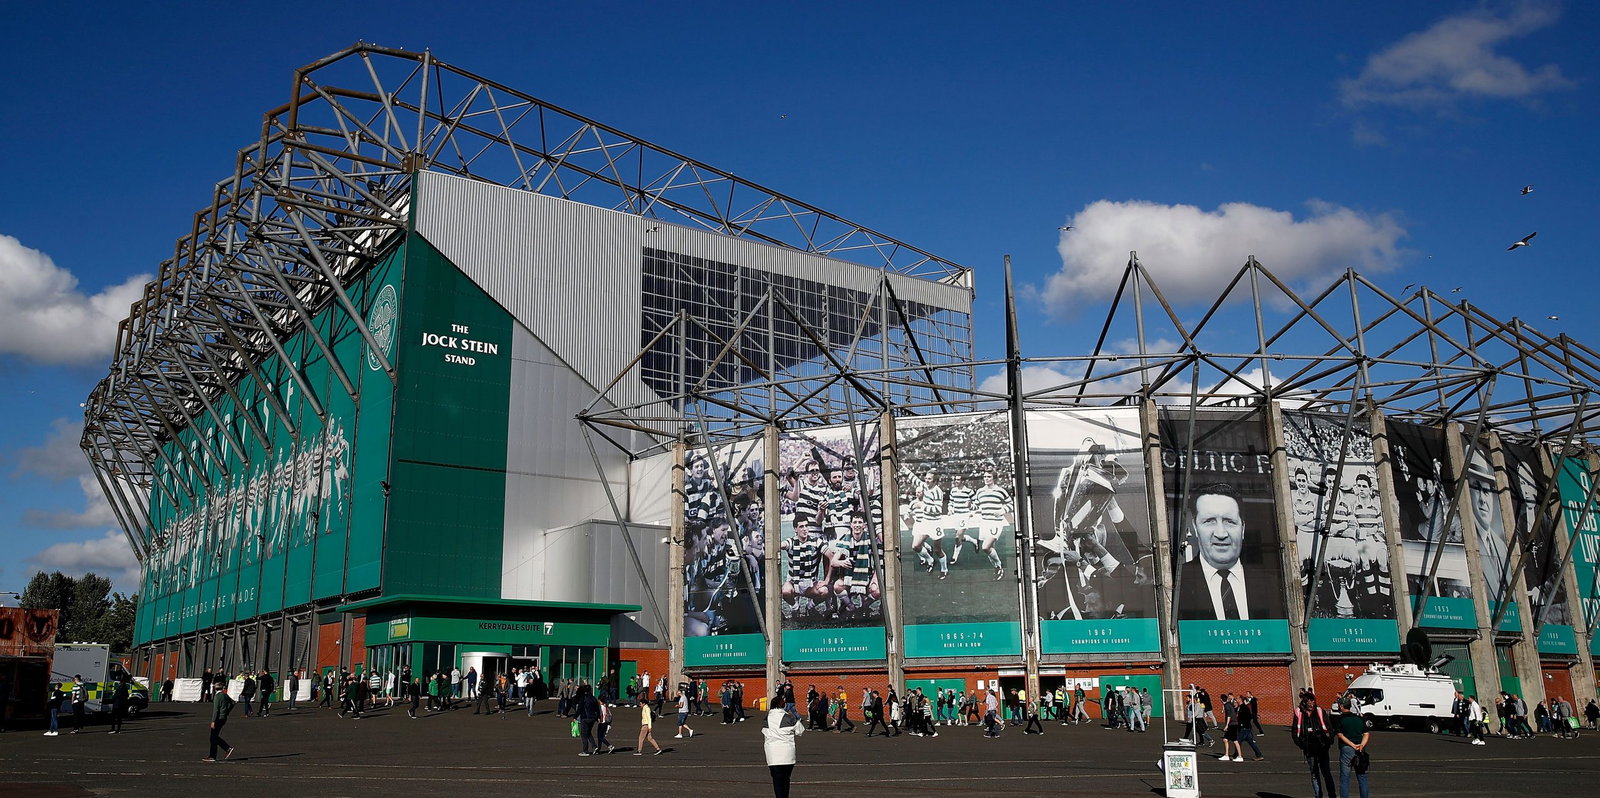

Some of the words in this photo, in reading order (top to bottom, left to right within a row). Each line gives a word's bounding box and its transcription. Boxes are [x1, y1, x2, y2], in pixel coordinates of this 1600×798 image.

[451, 323, 469, 334] THE
[422, 332, 458, 349] JOCK
[461, 339, 498, 355] STEIN
[445, 354, 476, 366] STAND
[1162, 448, 1245, 473] CELTIC
[211, 595, 227, 611] ARE
[479, 622, 519, 631] KERRYDALE
[545, 625, 552, 634] 7
[940, 632, 983, 640] 1965-74
